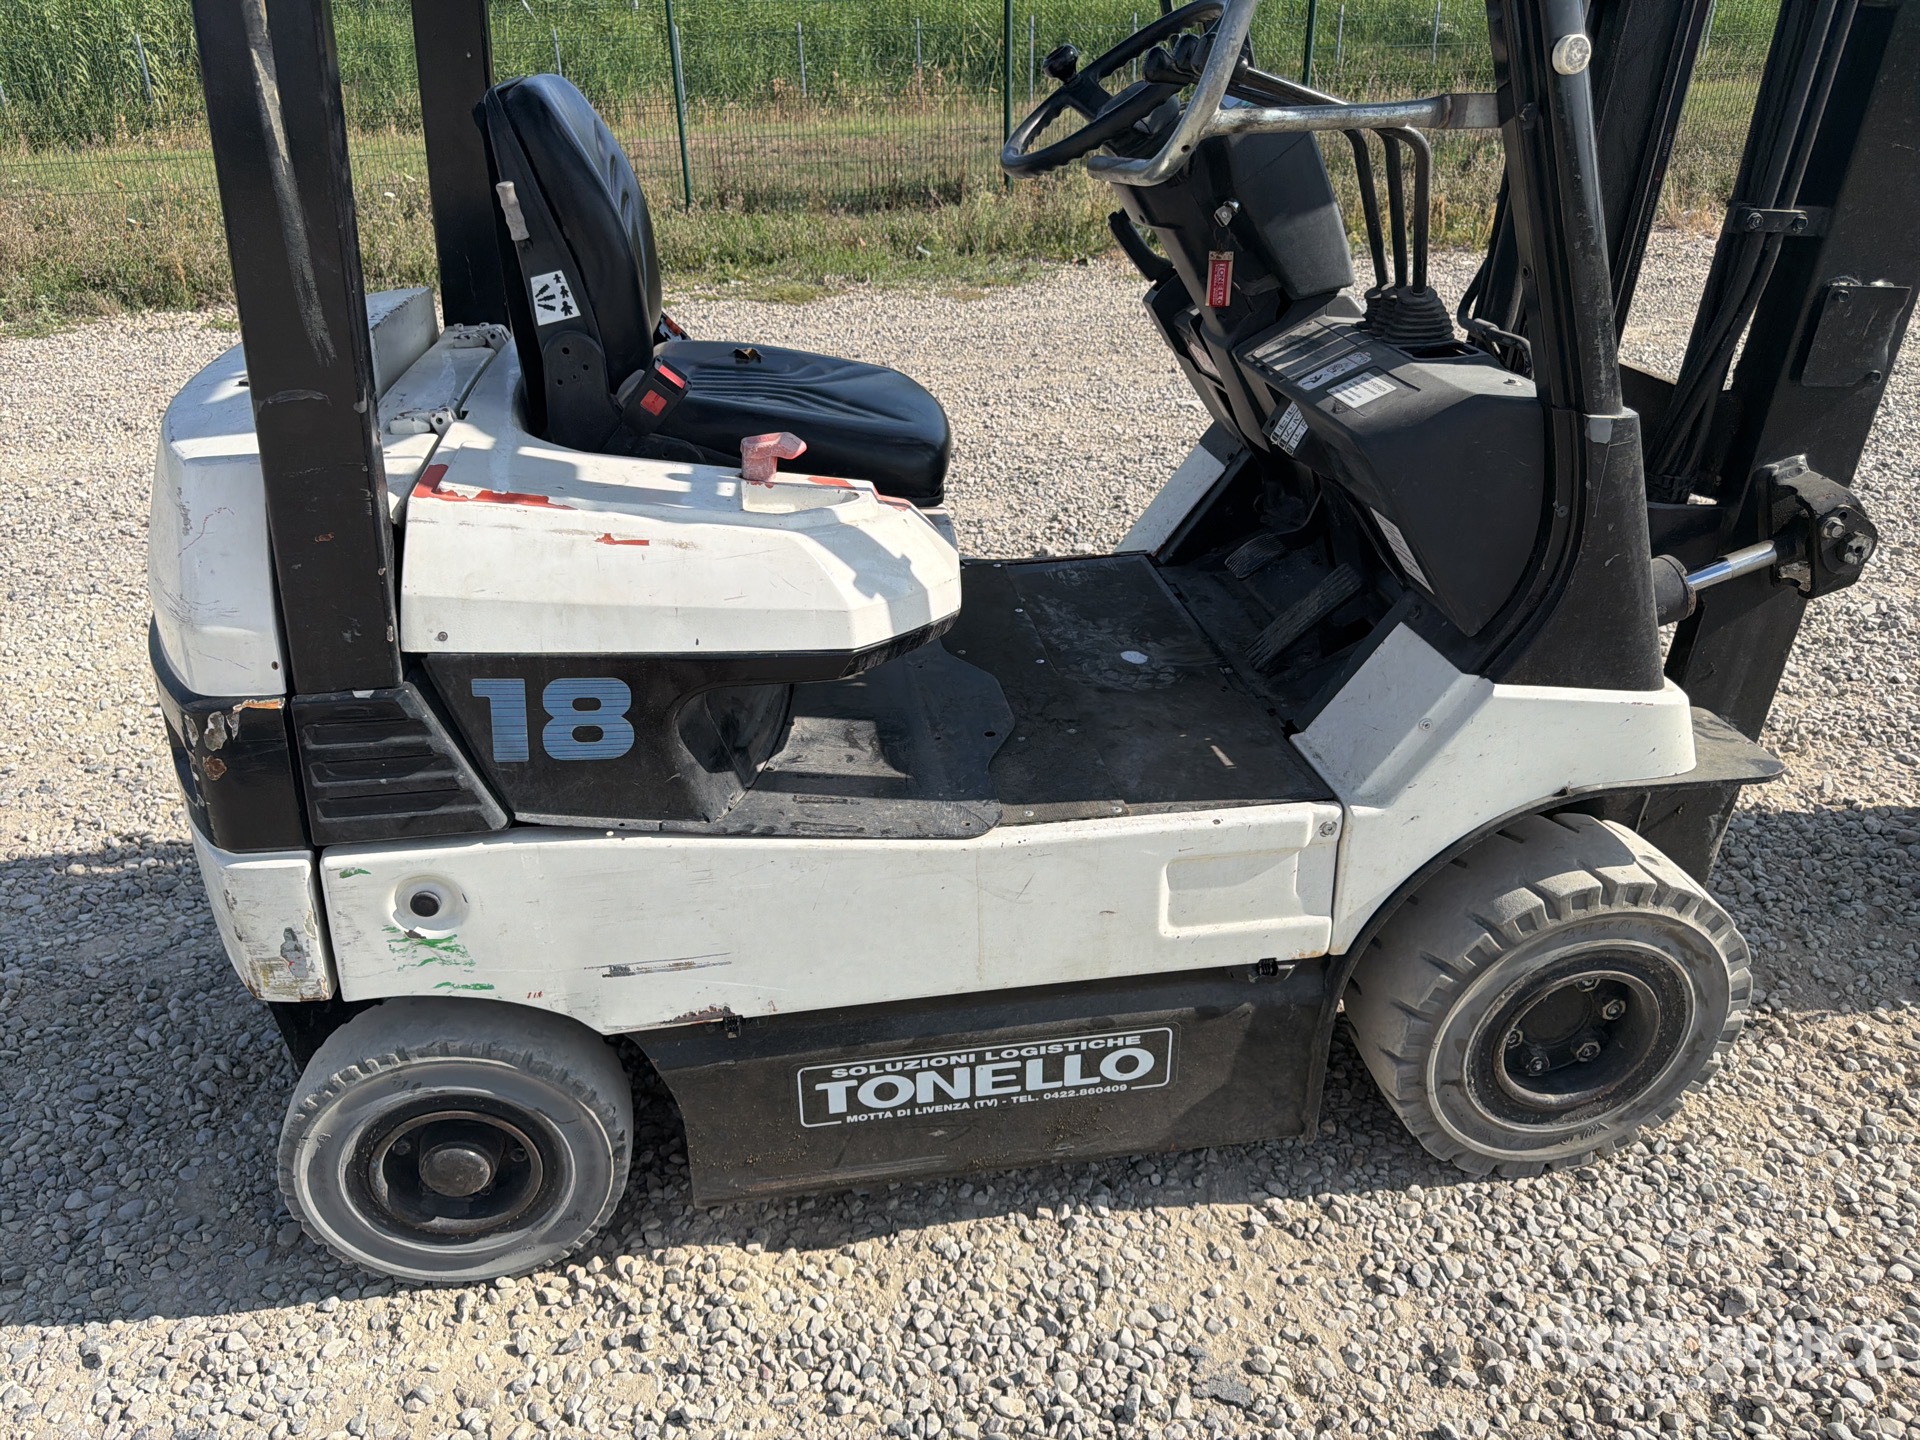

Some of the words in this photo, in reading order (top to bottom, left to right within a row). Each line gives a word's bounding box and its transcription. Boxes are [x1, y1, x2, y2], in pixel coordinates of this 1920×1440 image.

[1216, 263, 1226, 305] TONELLO
[471, 677, 635, 763] 18
[831, 1053, 976, 1079] SOLUZIONI
[985, 1035, 1142, 1061] LOGISTICHE
[814, 1047, 1155, 1115] TONELLO
[846, 1111, 894, 1123] MOTTA
[897, 1108, 912, 1118] DI
[915, 1102, 971, 1116] LIVENZA
[973, 1098, 998, 1110] (TV)
[1010, 1095, 1040, 1105] TEL.
[1043, 1084, 1128, 1100] 0422.860409
